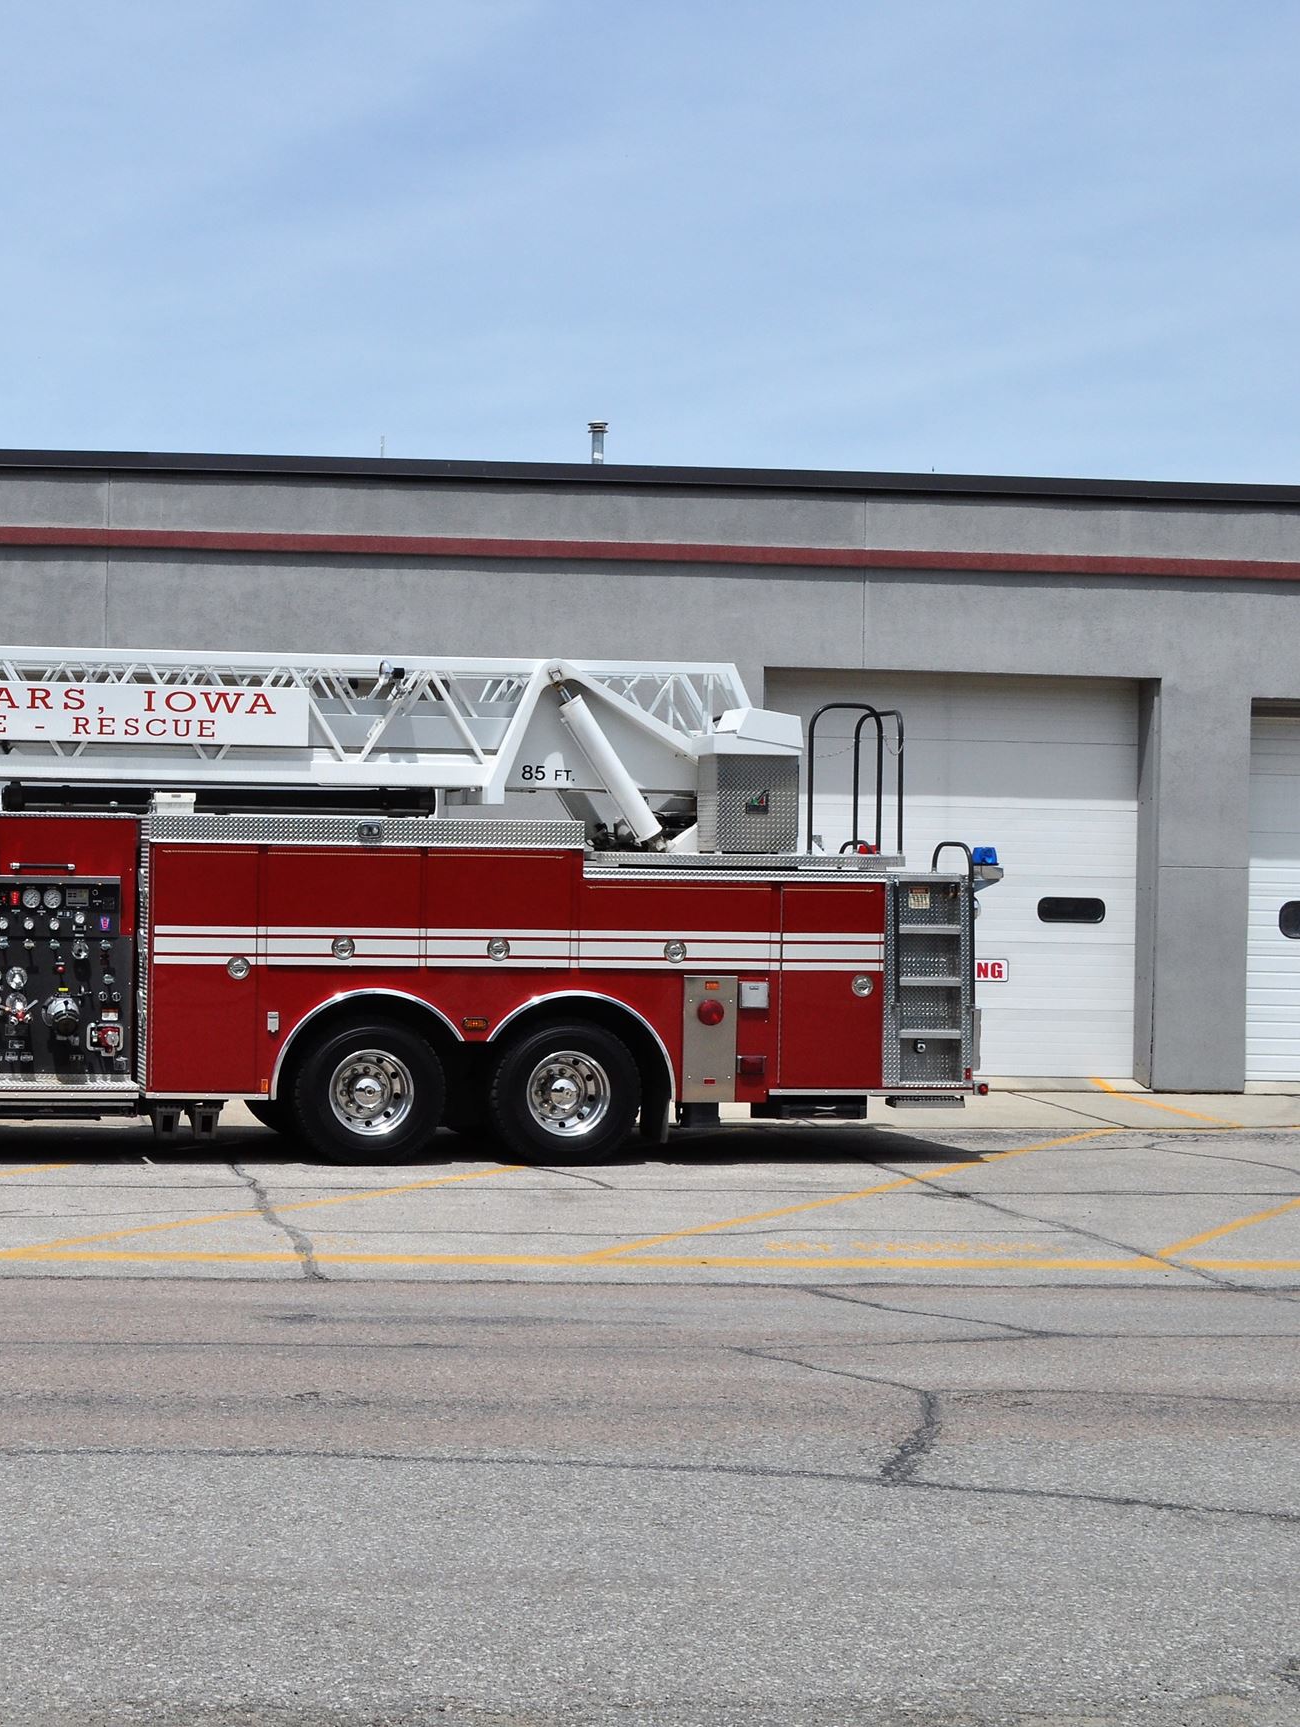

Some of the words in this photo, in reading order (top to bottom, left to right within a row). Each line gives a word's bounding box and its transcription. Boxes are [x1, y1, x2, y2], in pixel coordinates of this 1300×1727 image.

[144, 690, 276, 714] IOWA
[72, 716, 216, 738] RESCUE
[521, 765, 546, 781] 85
[554, 769, 576, 781] FT.
